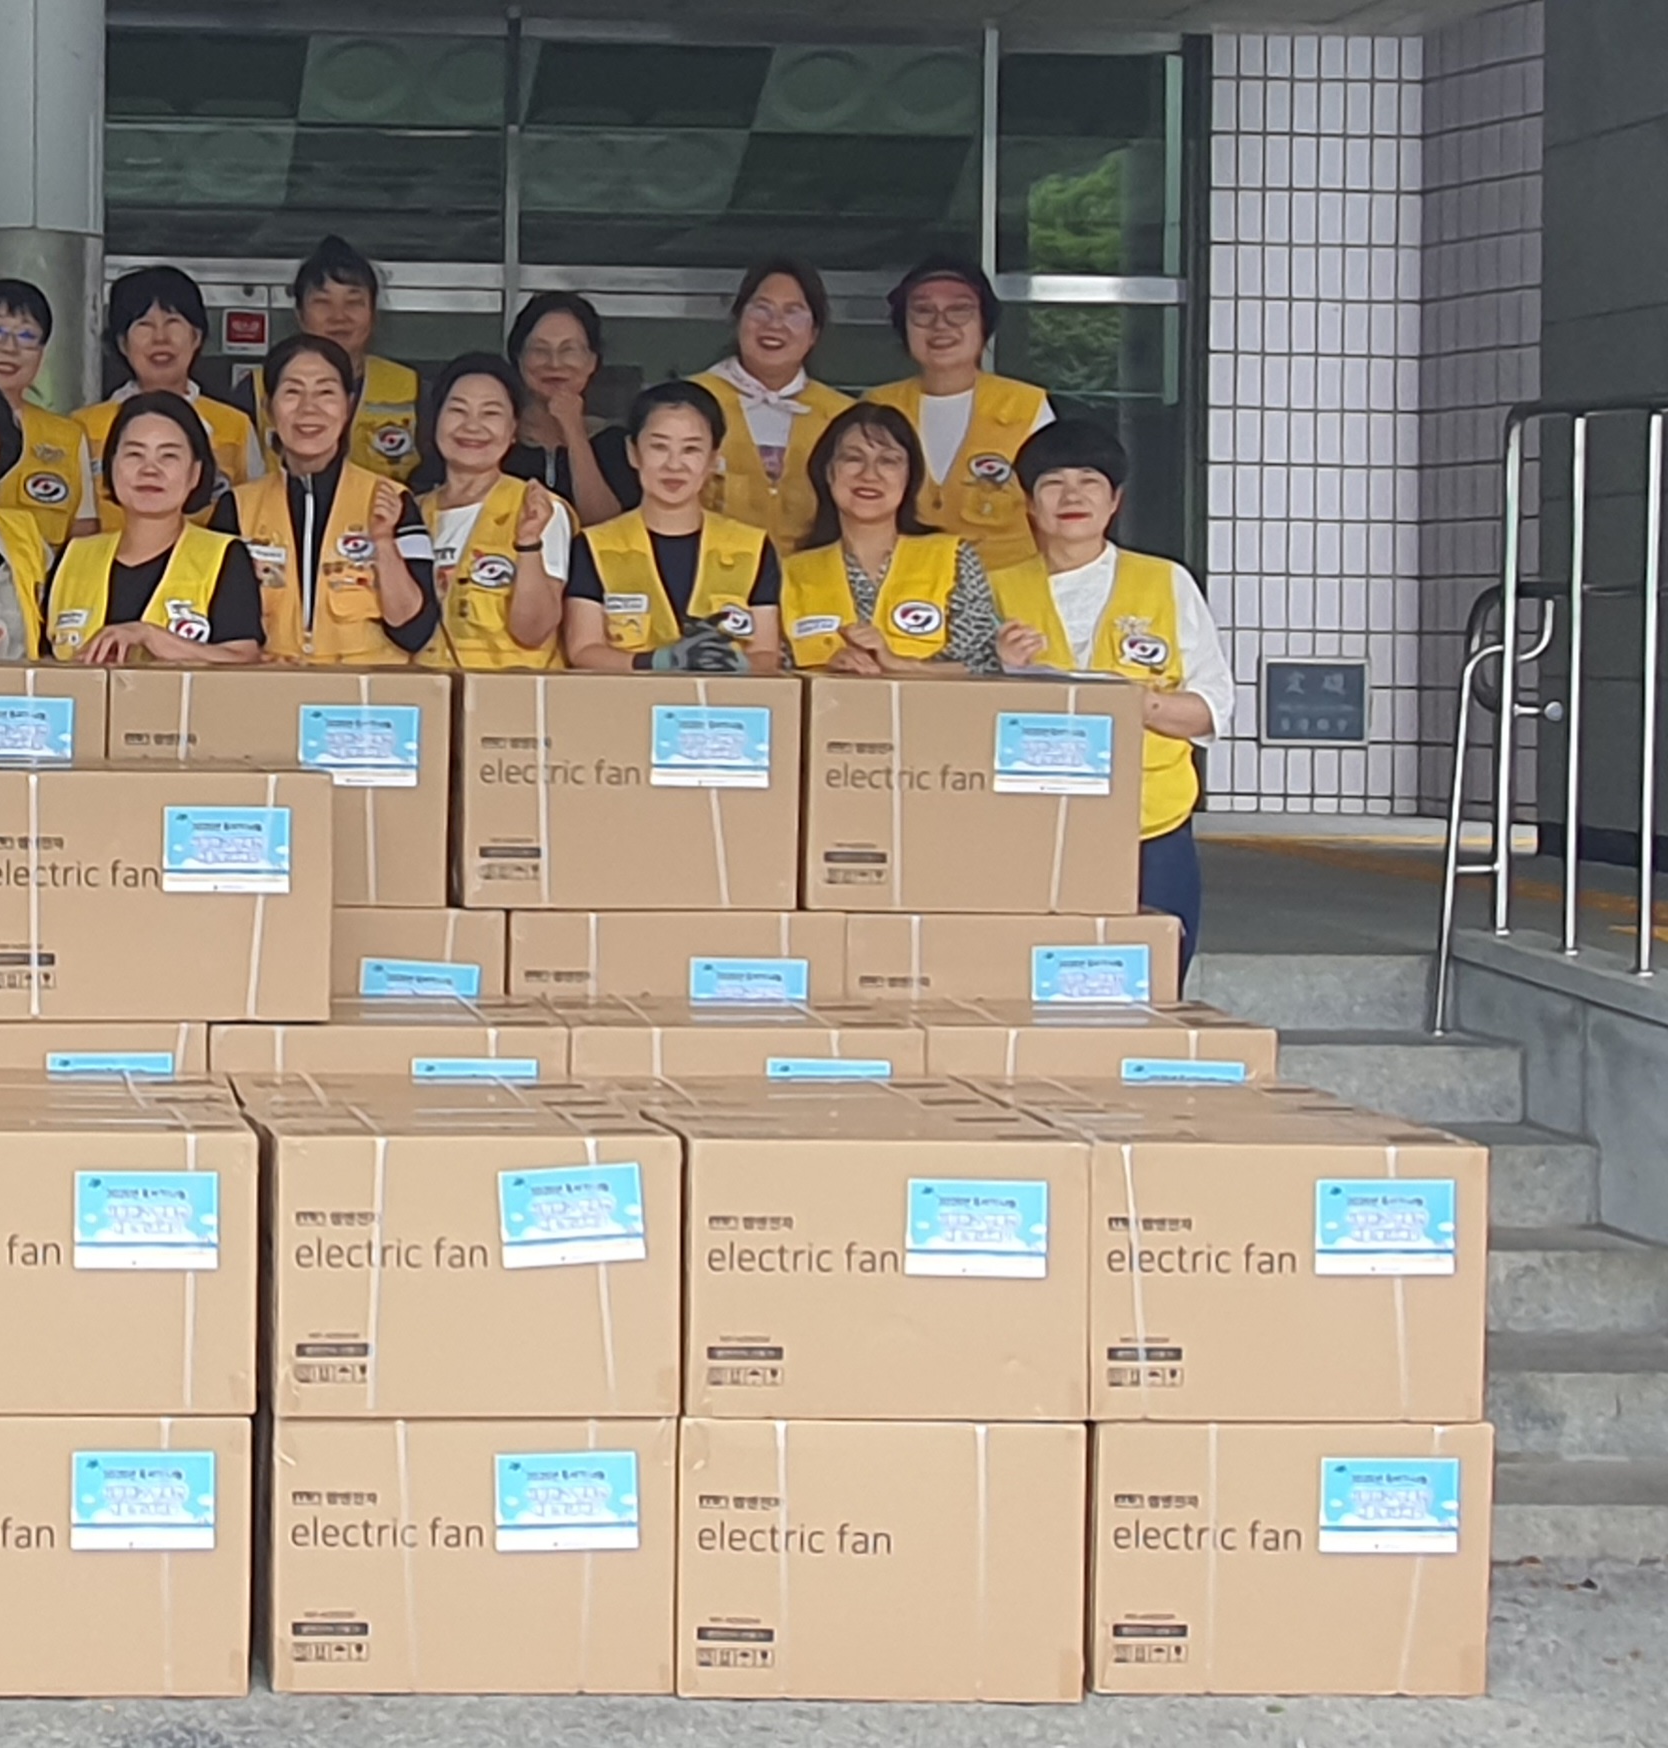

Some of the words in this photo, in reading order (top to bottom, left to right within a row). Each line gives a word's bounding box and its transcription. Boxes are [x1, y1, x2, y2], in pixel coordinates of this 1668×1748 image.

[480, 758, 584, 785] elecric
[595, 759, 640, 785] fan
[826, 763, 930, 790] electric
[940, 764, 985, 790] fan
[111, 859, 160, 888] fan
[8, 1234, 60, 1266] fan
[295, 1237, 422, 1268] electric
[434, 1237, 488, 1268] fan
[708, 1241, 832, 1272] electric
[845, 1242, 898, 1273] fan
[1107, 1238, 1231, 1274] electric
[1244, 1243, 1296, 1274] fan
[1, 1517, 54, 1549] fan
[291, 1516, 417, 1548] electric
[430, 1517, 483, 1548] fan
[698, 1520, 824, 1553] electric
[838, 1523, 891, 1554] fan
[1114, 1519, 1237, 1551] electric
[1249, 1520, 1301, 1551] fan
